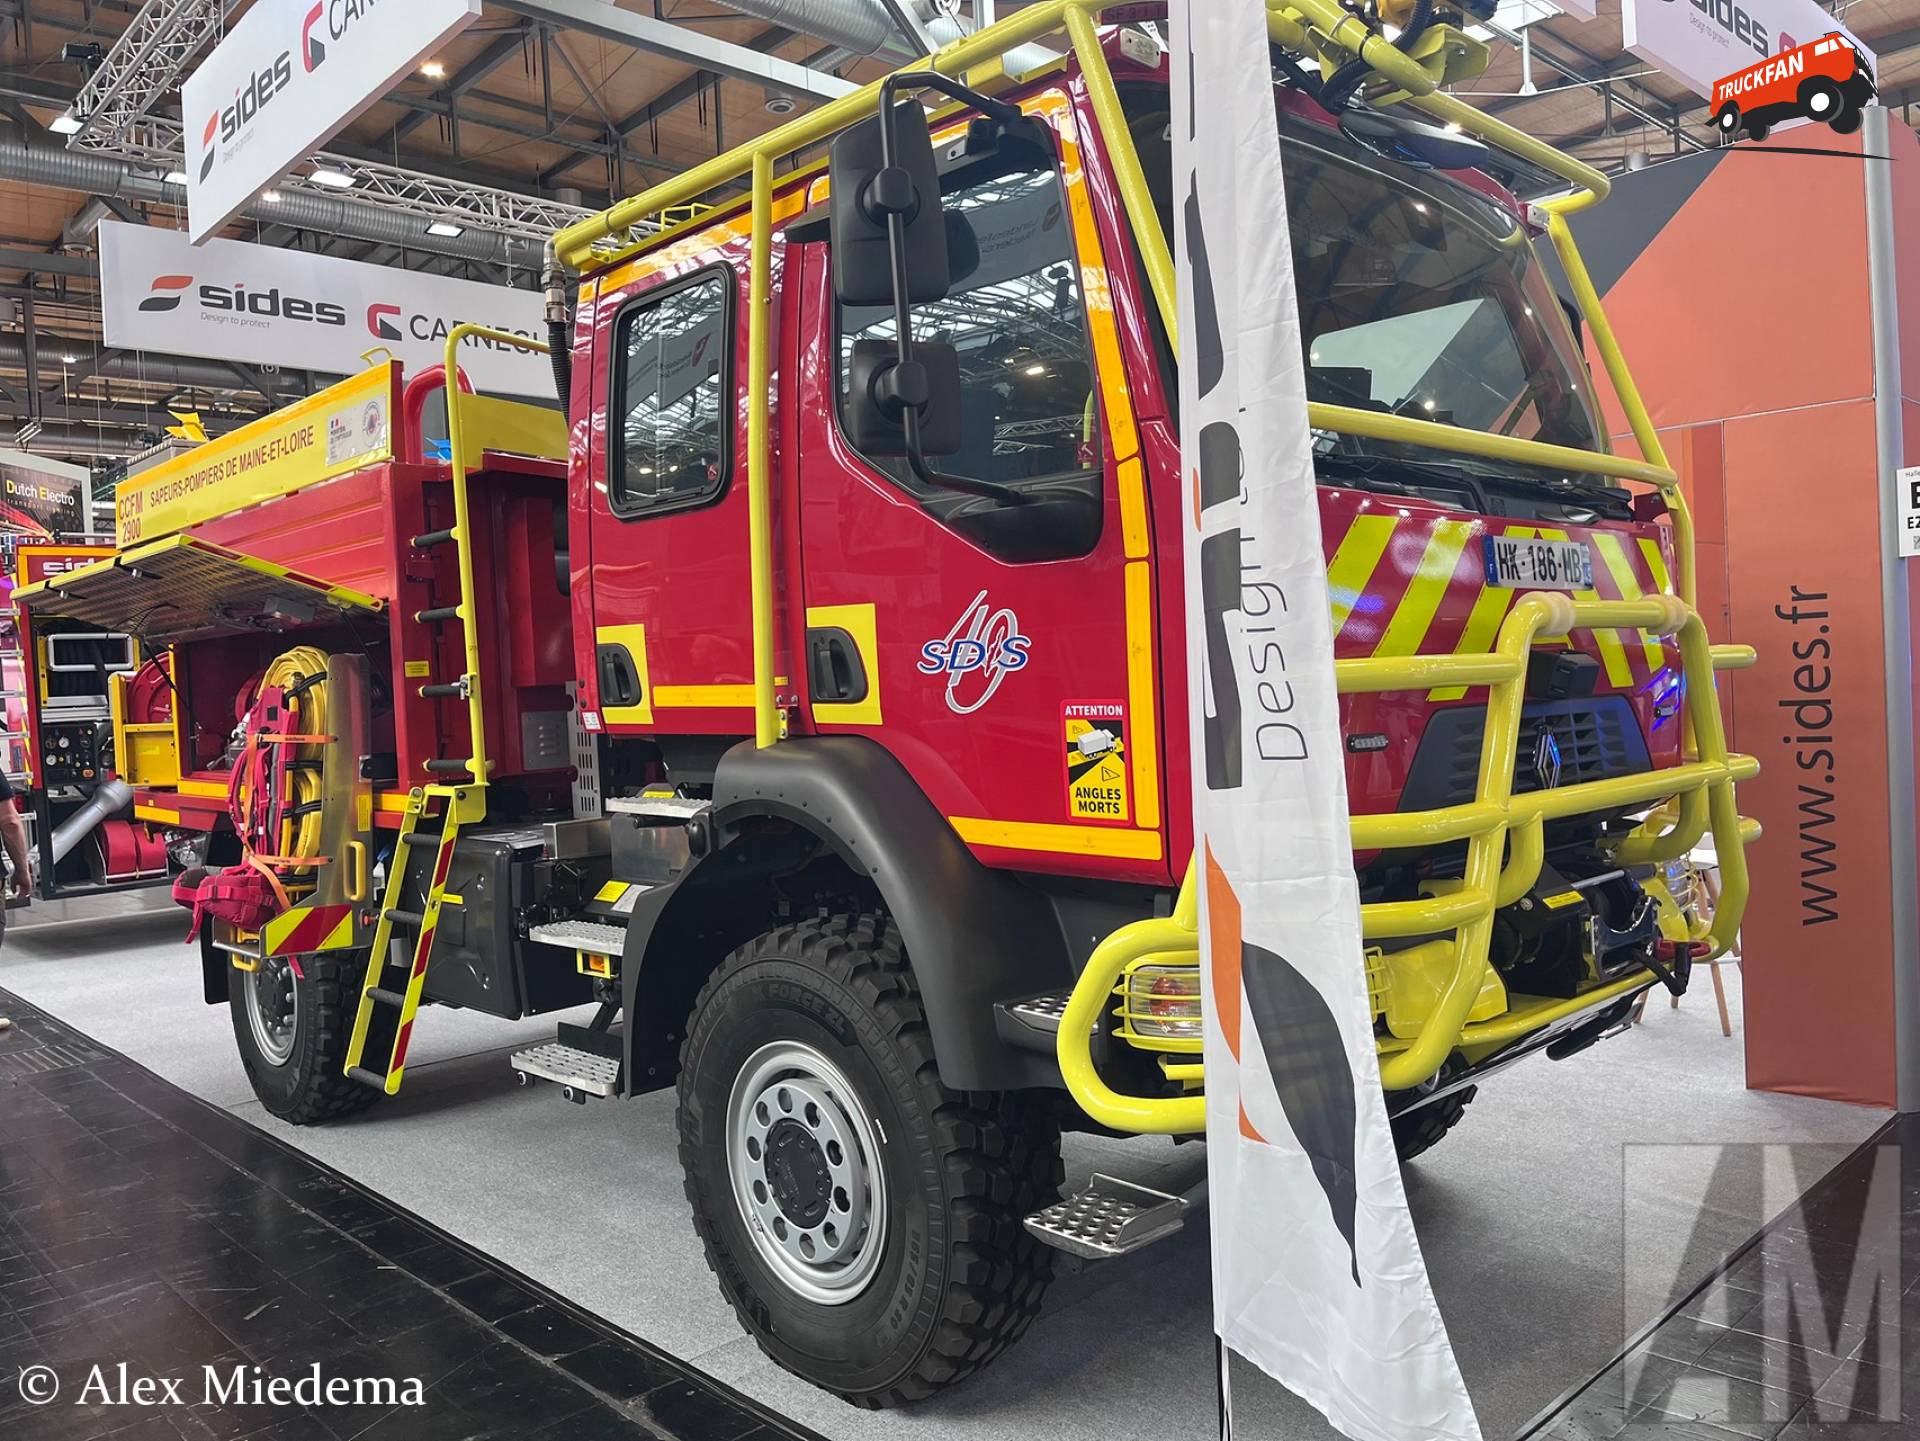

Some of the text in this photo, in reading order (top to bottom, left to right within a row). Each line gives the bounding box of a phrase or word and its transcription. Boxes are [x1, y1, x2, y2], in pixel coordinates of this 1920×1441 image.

[221, 50, 291, 143] sides
[199, 283, 346, 326] sides
[200, 312, 229, 325] Design
[240, 319, 271, 329] protect
[150, 425, 315, 507] SAPEURS-POMPIERS DE MAINE-ET-LOIRE
[6, 480, 75, 506] Dutch Electro
[119, 490, 144, 521] CCFM
[122, 517, 142, 543] 2900
[1065, 704, 1124, 716] ATTENTION
[1774, 585, 1839, 927] www.sides.fr
[1075, 787, 1122, 800] ANGLES
[1078, 801, 1121, 814] MORTS
